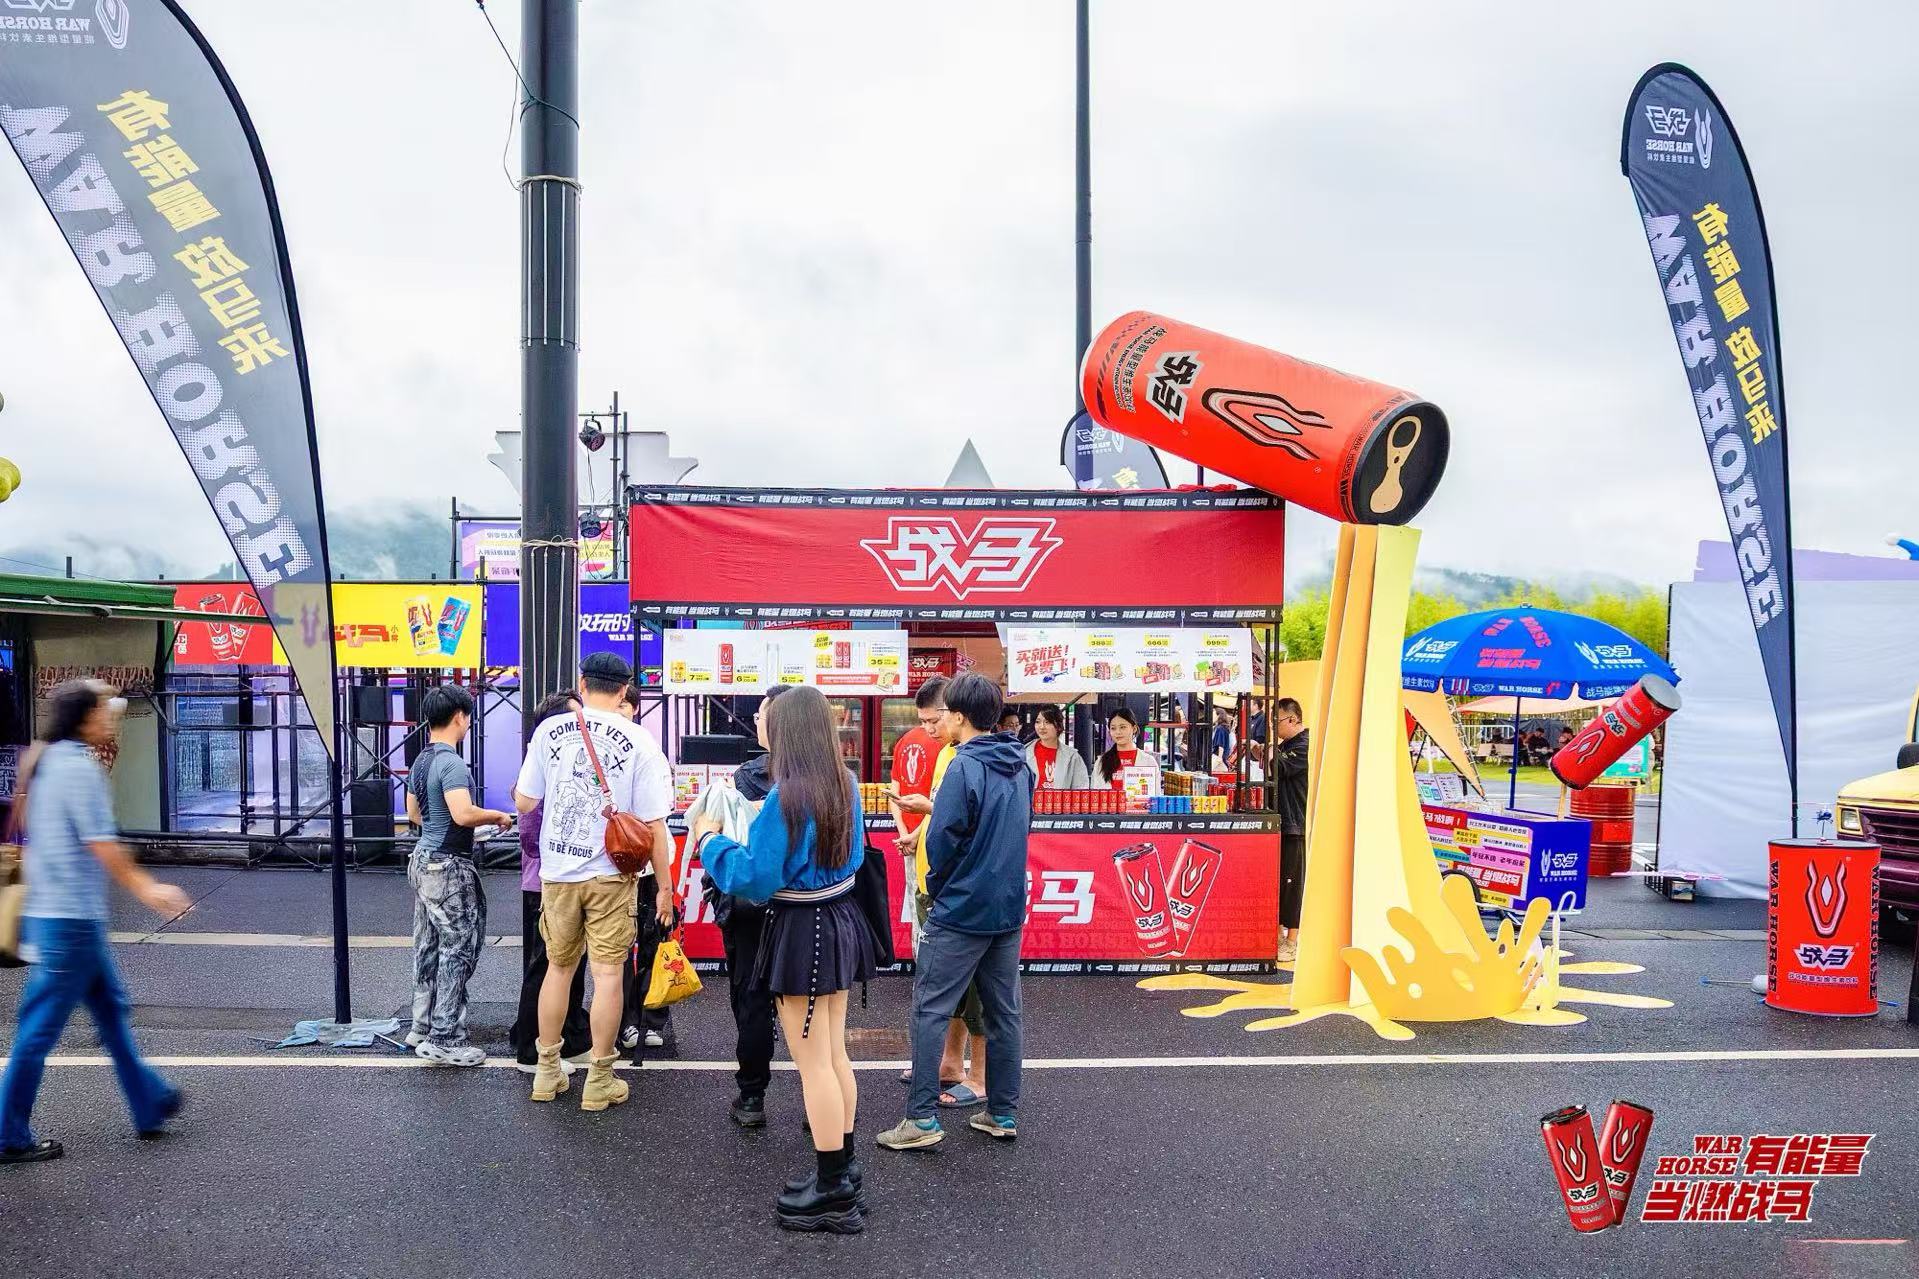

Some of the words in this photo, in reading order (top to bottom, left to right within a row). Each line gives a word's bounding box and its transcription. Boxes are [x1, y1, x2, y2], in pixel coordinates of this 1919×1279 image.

[1498, 685, 1515, 694] WAR
[1515, 686, 1543, 695] HORSE
[606, 725, 634, 753] VETS
[548, 842, 556, 851] TO
[556, 843, 566, 854] BE
[567, 845, 594, 859] FOCUS
[1769, 859, 1779, 908] WAR
[1870, 863, 1880, 914] WAR
[1768, 914, 1778, 993] HORSE
[1869, 917, 1880, 1000] HORSE
